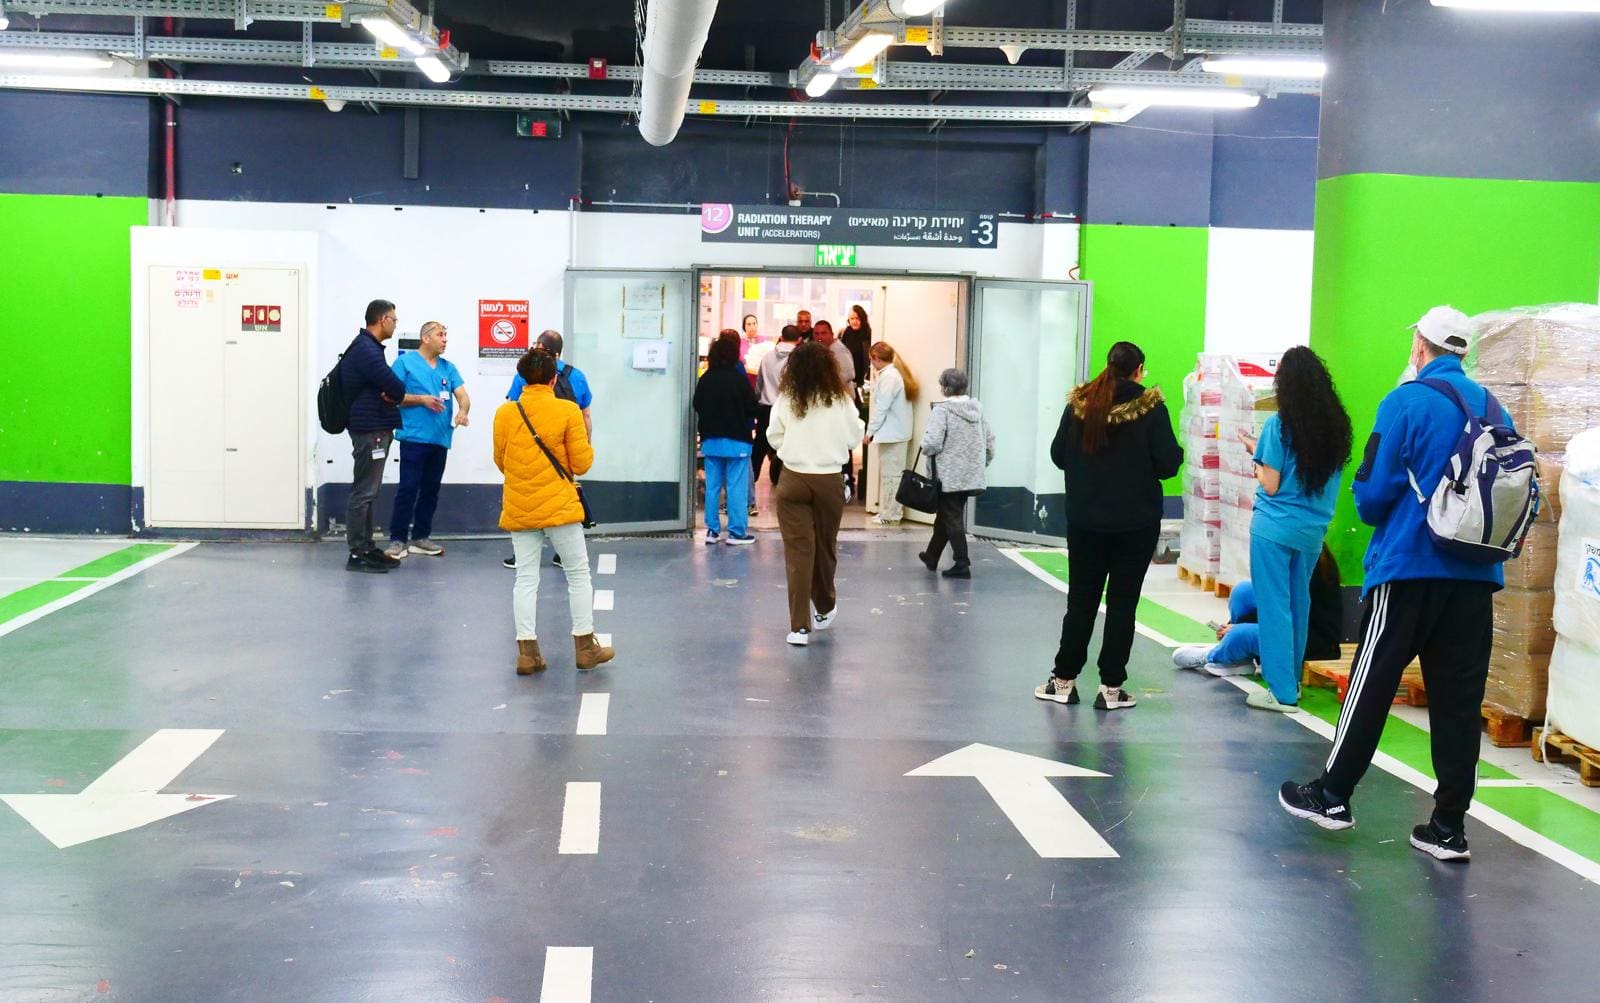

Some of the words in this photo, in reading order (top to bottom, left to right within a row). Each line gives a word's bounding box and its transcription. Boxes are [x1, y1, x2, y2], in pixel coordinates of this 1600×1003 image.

[705, 207, 724, 221] 12
[737, 213, 788, 225] RADIATION
[789, 214, 833, 226] THERAPY
[848, 216, 889, 227] (מאיצים)
[892, 216, 927, 229] קרינה
[930, 217, 965, 228] יחידת
[737, 226, 760, 237] UNIT
[761, 228, 821, 239] (ACCELERATORS)
[943, 233, 963, 243] وحدة
[971, 221, 994, 245] -3
[818, 245, 855, 266] יציאה
[480, 302, 504, 313] לעשן
[505, 304, 528, 312] אסור
[1326, 804, 1346, 816] HOKA
